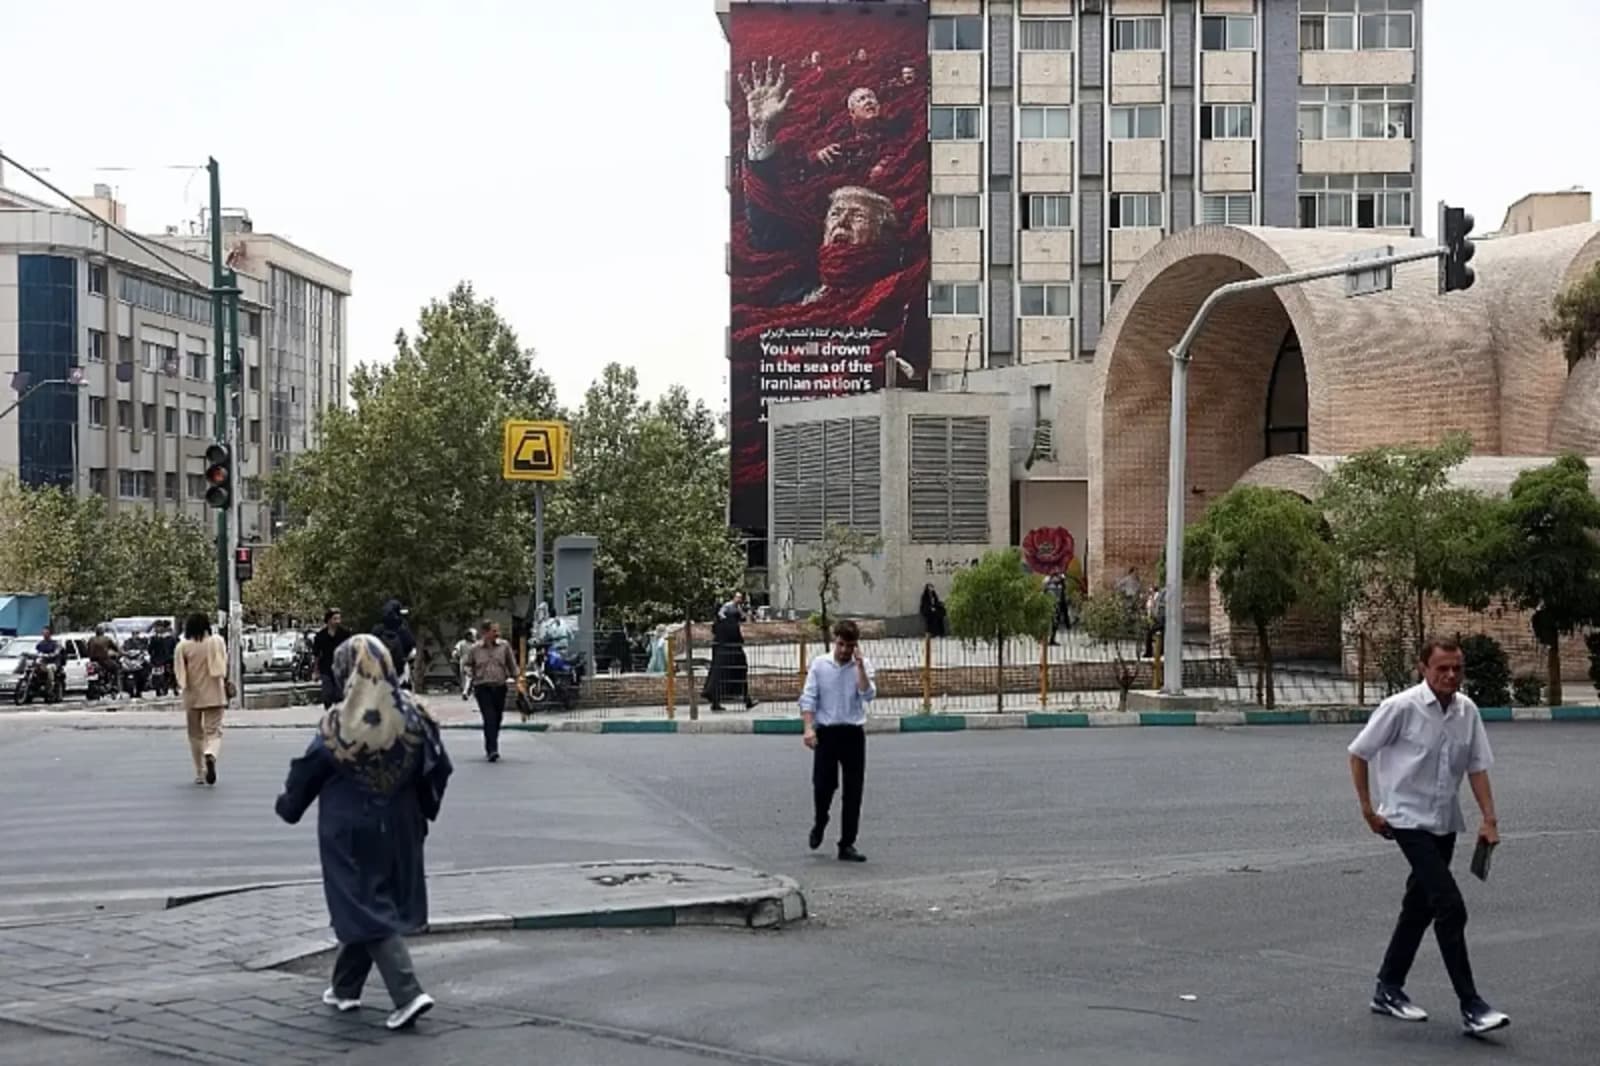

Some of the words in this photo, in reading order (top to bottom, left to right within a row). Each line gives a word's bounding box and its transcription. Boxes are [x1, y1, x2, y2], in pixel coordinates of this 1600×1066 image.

[760, 342, 789, 356] You
[791, 342, 819, 356] will
[821, 342, 870, 356] drown
[760, 359, 775, 373] in
[777, 359, 801, 373] the
[803, 362, 829, 373] sea
[831, 359, 847, 373] of
[848, 359, 873, 373] the
[761, 377, 811, 391] Iranian
[814, 377, 871, 391] nation's
